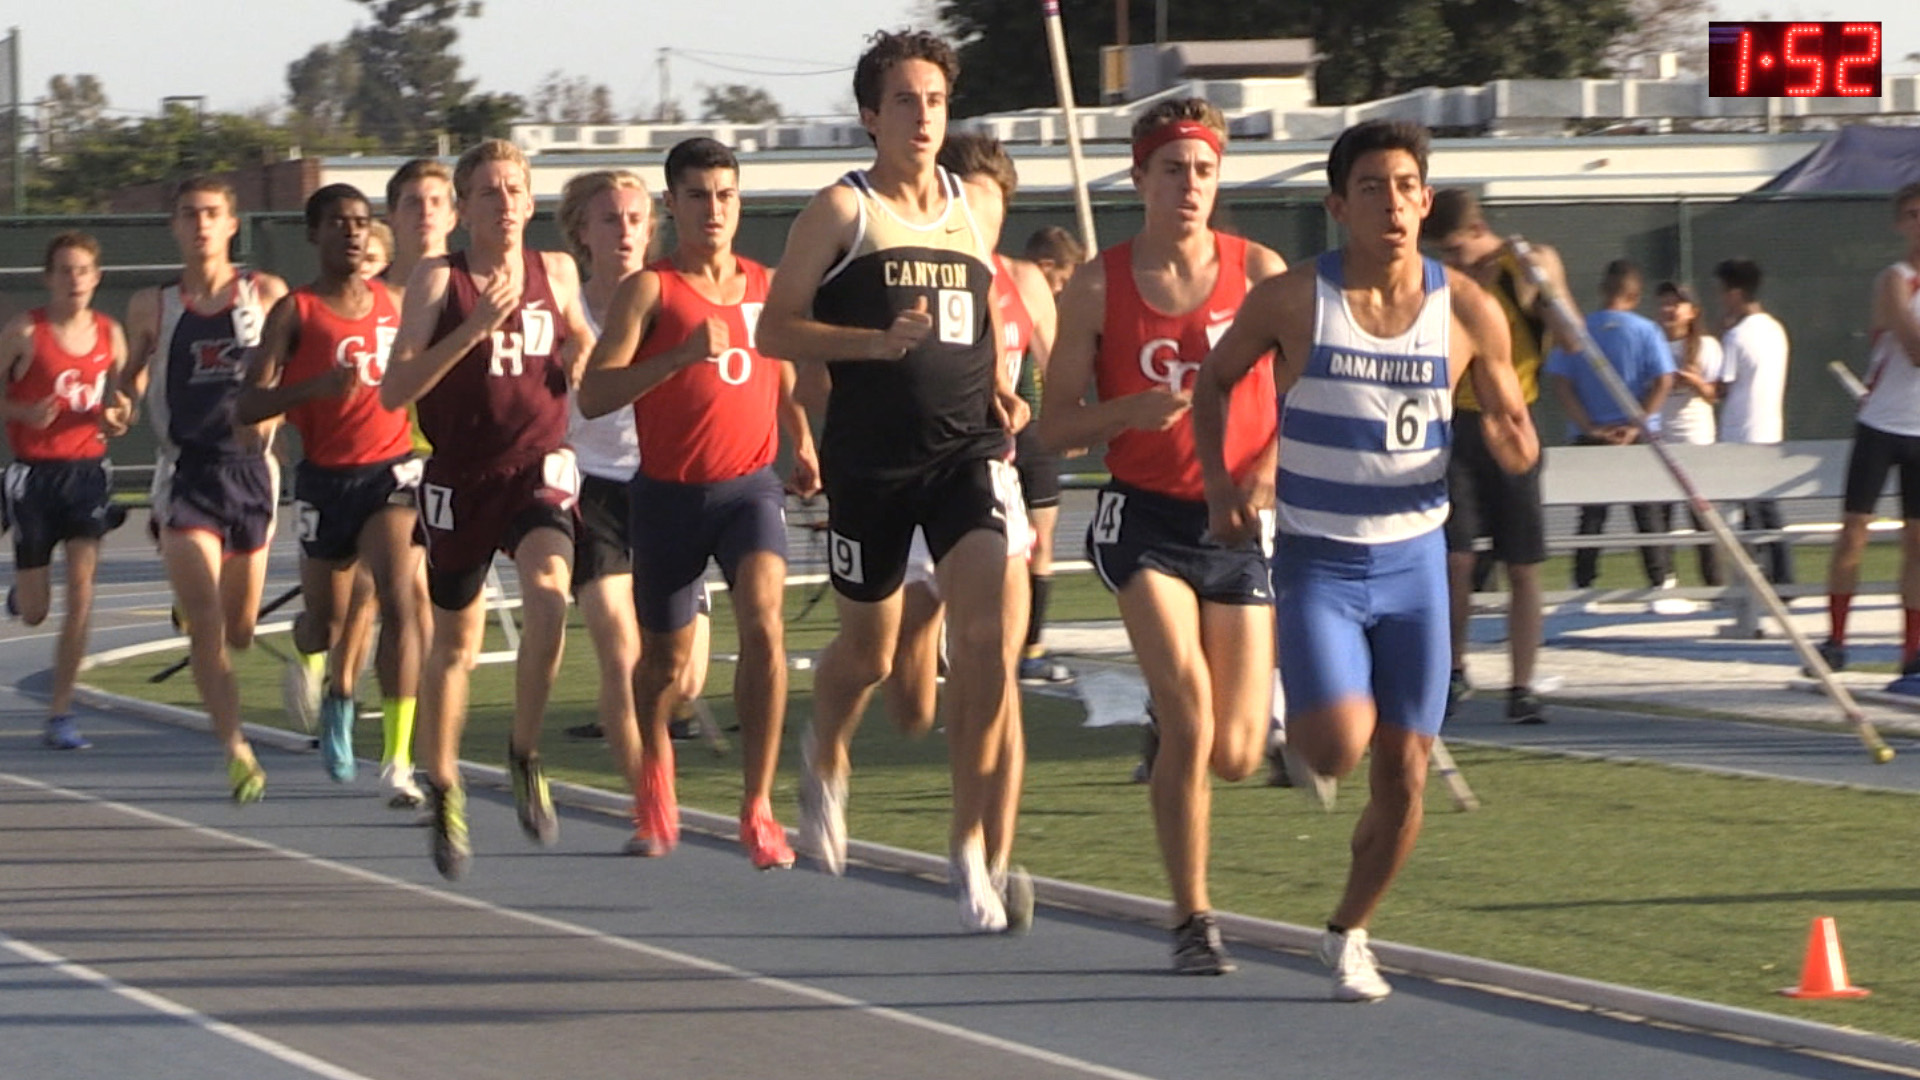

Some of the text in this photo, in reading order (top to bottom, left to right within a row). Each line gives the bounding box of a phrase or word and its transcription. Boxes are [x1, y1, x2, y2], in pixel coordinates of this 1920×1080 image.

[884, 260, 968, 288] CANYON
[530, 314, 546, 352] 7
[947, 294, 966, 339] 9
[190, 338, 247, 384] K
[489, 331, 524, 377] H
[704, 347, 752, 386] O
[1329, 352, 1434, 384] DANA HILLS
[1395, 398, 1419, 447] 6
[429, 488, 445, 525] 7
[1099, 495, 1119, 539] 4
[836, 538, 855, 576] 9
